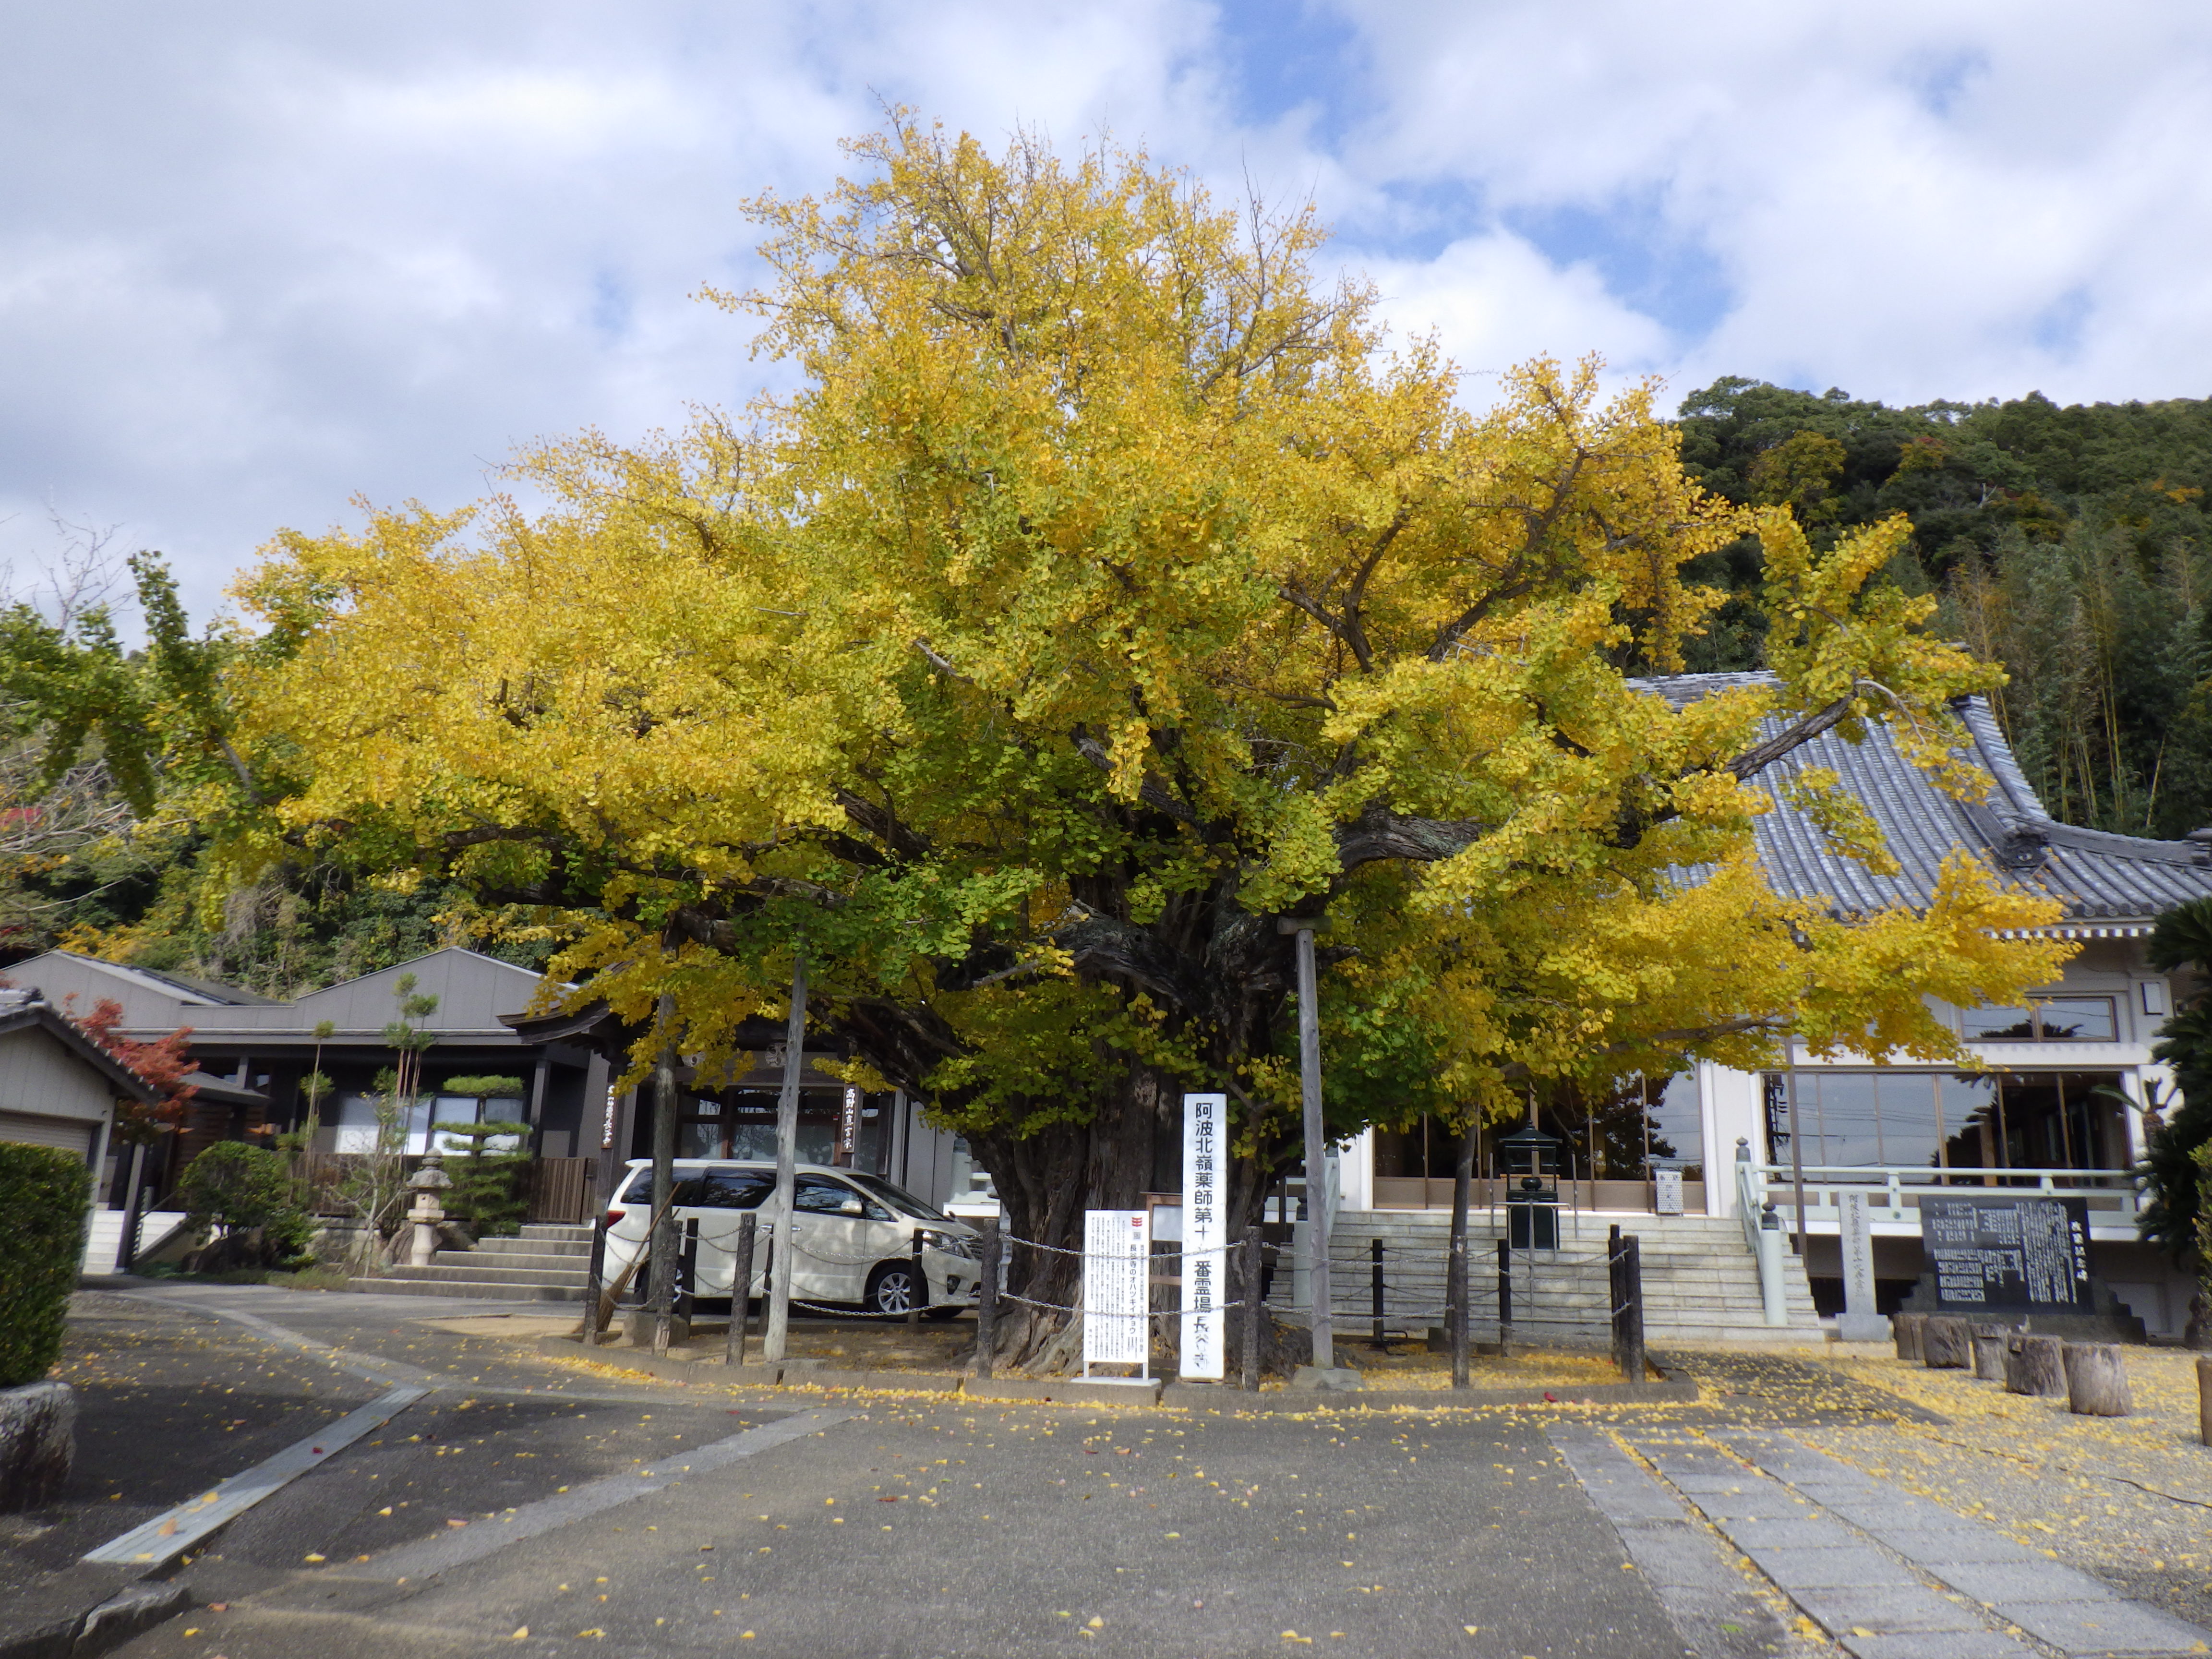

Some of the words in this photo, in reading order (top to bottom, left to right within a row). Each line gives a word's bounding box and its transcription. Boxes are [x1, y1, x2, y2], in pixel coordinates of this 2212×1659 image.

[843, 1088, 855, 1149] 高野山真言宗
